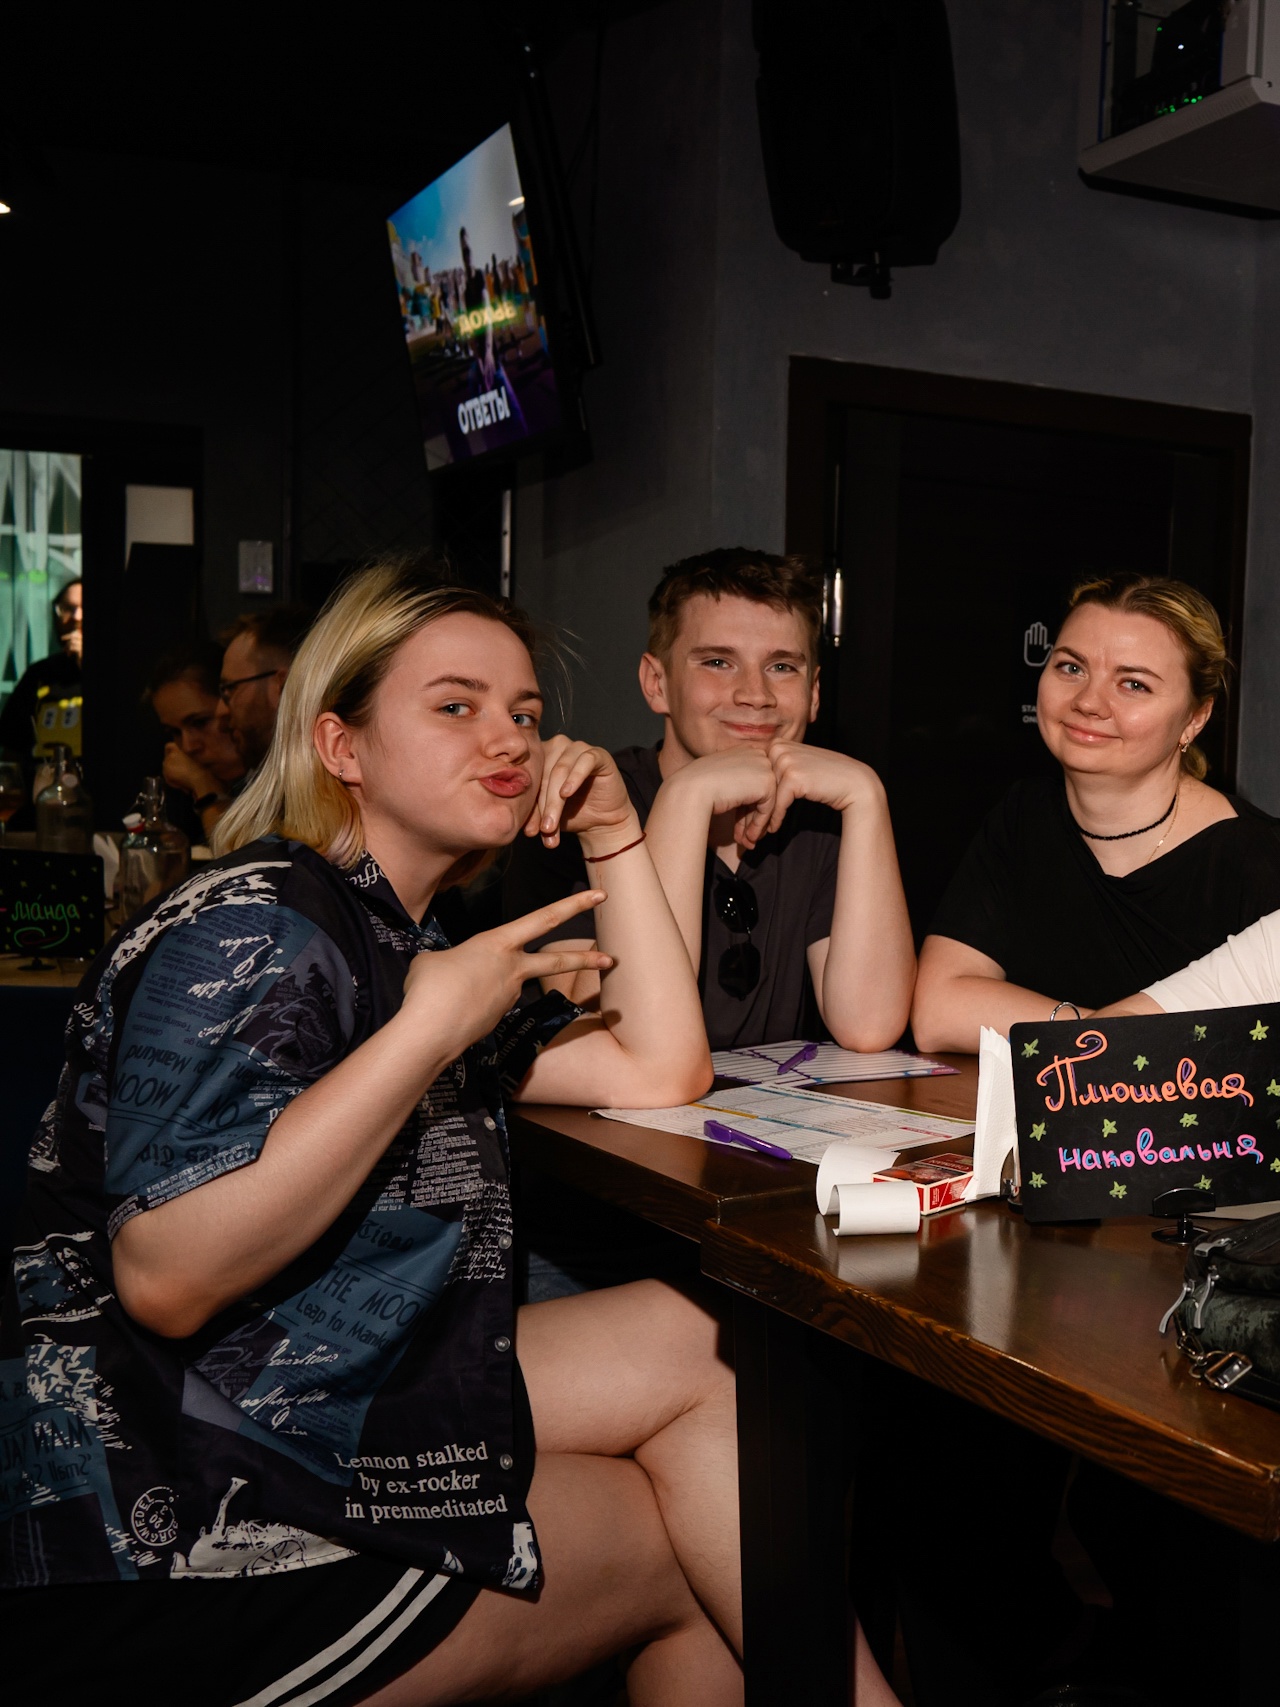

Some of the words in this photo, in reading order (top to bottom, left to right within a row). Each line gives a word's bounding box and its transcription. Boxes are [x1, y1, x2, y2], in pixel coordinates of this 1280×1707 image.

[457, 386, 512, 435] ОТВЕТЫ
[125, 1044, 194, 1074] Mankind
[1036, 1030, 1254, 1112] Плюшевая
[1058, 1127, 1264, 1173] наковальня
[296, 1293, 327, 1325] Leap
[333, 1451, 410, 1472] Lennon
[416, 1442, 489, 1467] stalked
[361, 1474, 380, 1496] by
[386, 1471, 481, 1495] ex-rocker
[345, 1499, 363, 1519] in
[370, 1494, 508, 1524] prenmeditated
